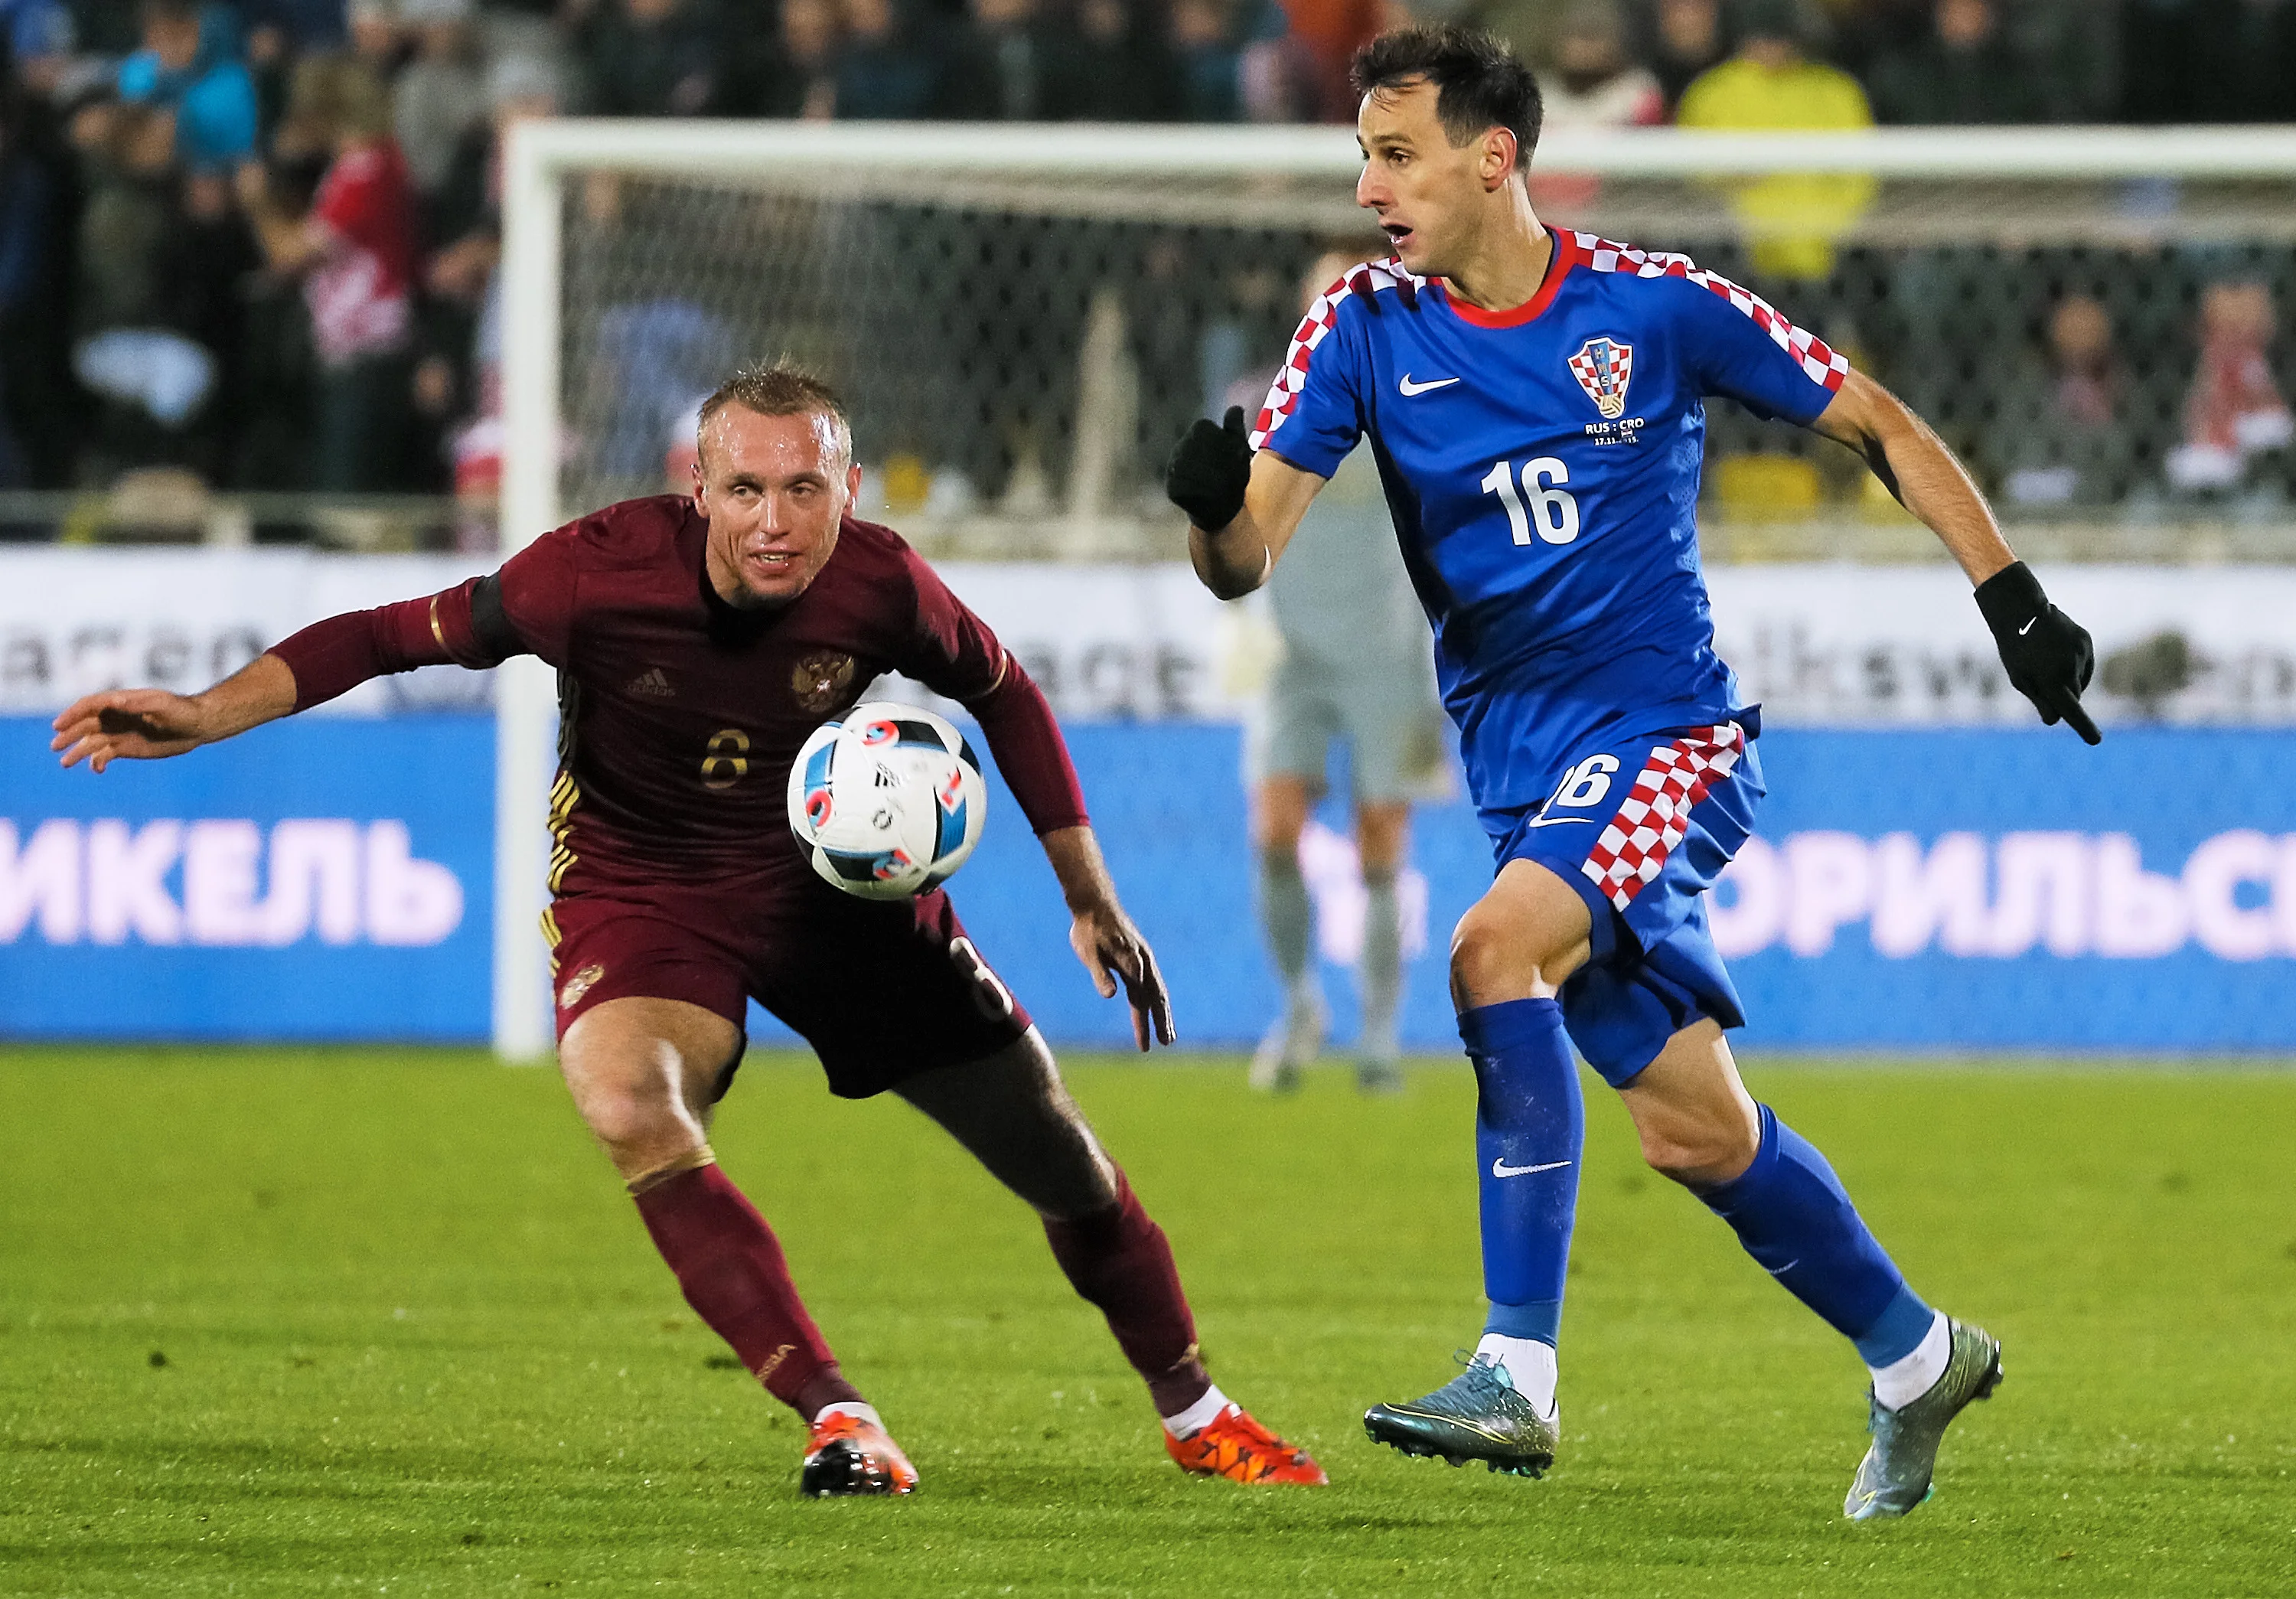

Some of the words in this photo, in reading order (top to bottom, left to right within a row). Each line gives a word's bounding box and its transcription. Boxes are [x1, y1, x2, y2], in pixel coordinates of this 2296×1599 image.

[1585, 423, 1609, 435] RUS
[1619, 417, 1645, 430] CRO
[1481, 456, 1580, 546] 16
[701, 729, 750, 789] 8
